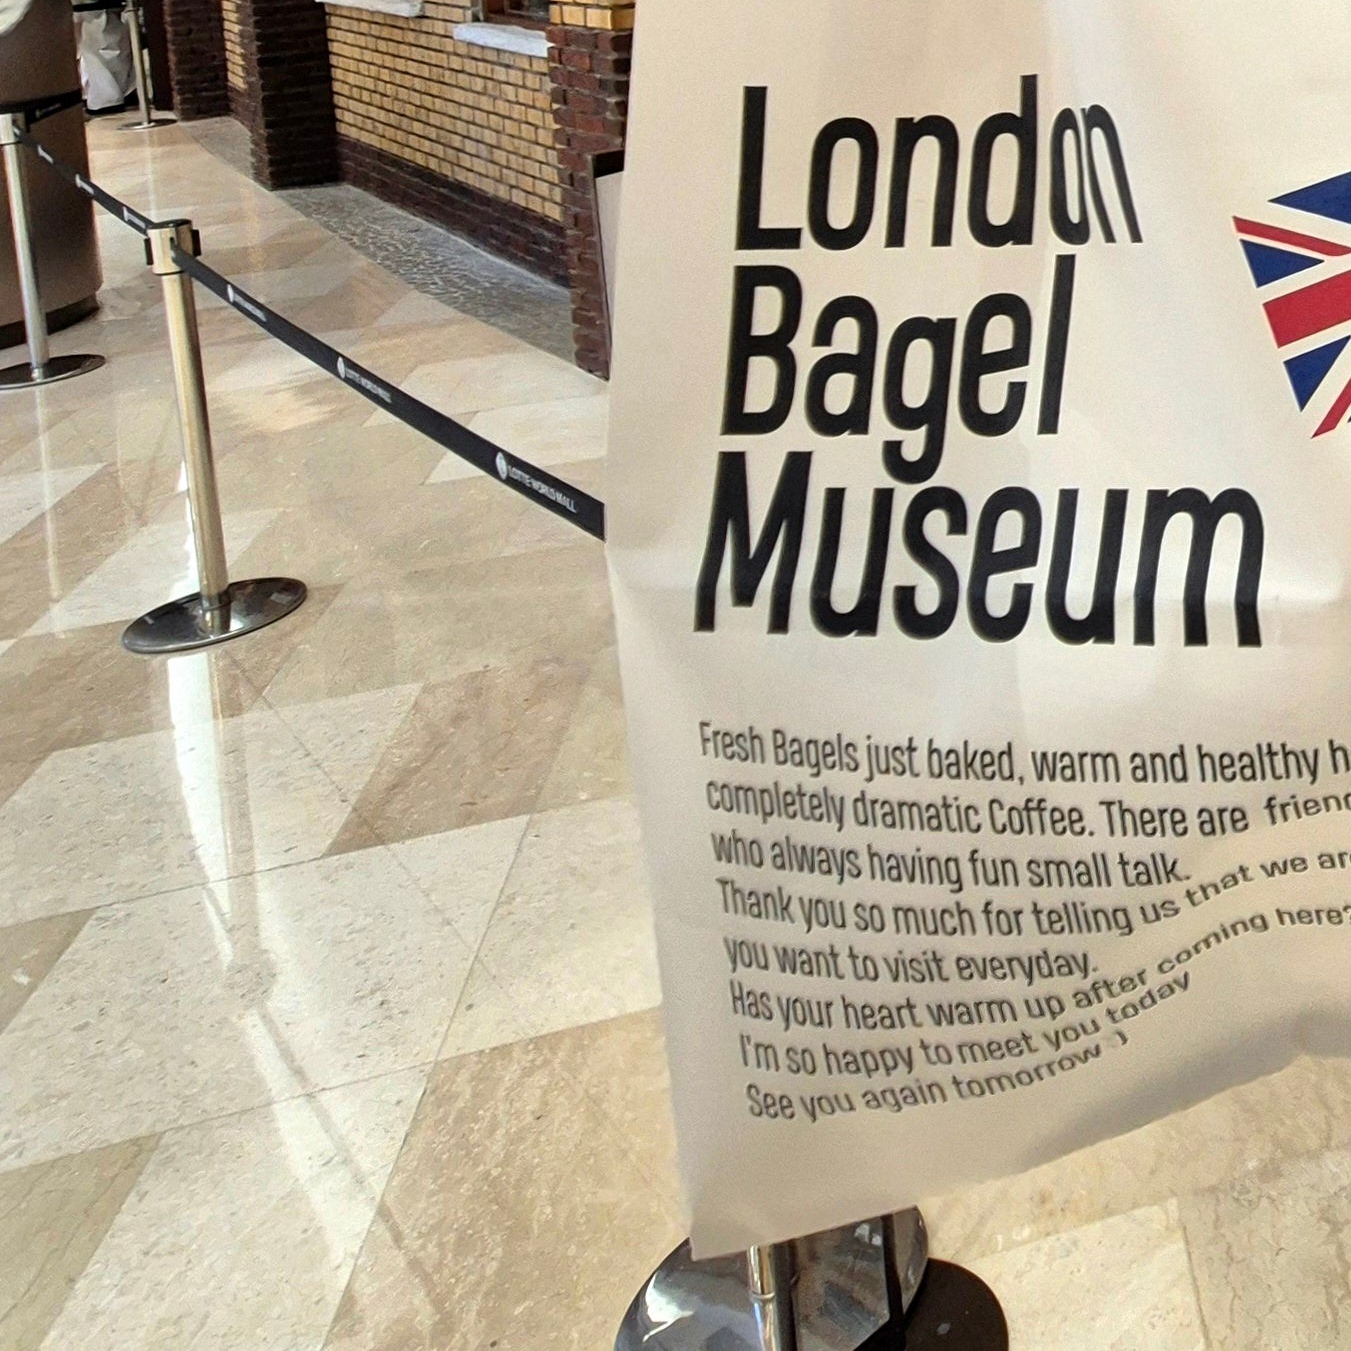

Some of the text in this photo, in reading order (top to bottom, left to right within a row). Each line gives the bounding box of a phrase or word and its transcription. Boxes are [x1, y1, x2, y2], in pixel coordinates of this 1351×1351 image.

[734, 74, 1143, 251] London
[720, 254, 1077, 485] Bagel
[693, 449, 1265, 648] Museum
[699, 719, 767, 765] Fresh
[772, 727, 860, 778] Bagels
[864, 734, 920, 782] just
[928, 740, 1025, 785] baked,
[1031, 750, 1121, 784] warm
[1129, 744, 1189, 784] and
[1197, 742, 1320, 785] healthy
[706, 780, 845, 831] completely
[853, 794, 982, 833] dramatic
[989, 798, 1095, 837] Coffee.
[1099, 800, 1189, 838] There
[1198, 806, 1250, 837] are
[711, 830, 1192, 894] who always having fun small talk.
[716, 877, 795, 923] Thank
[799, 894, 847, 934] you
[854, 905, 885, 933] so
[893, 902, 975, 937] much
[983, 902, 1024, 937] for
[1032, 901, 1133, 937] telling
[1141, 899, 1181, 925] us
[1185, 864, 1254, 908] that
[1260, 854, 1309, 879] we
[724, 937, 1098, 986] you want to visit everyday.
[730, 980, 773, 1021] Has
[777, 994, 834, 1033] your
[842, 996, 923, 1030] heart
[927, 999, 1017, 1027] warm
[1024, 994, 1067, 1022] up
[1072, 968, 1147, 1009] after
[1156, 911, 1269, 975] coming
[739, 970, 1190, 1080] I'm so happy to meet you today
[745, 1083, 795, 1120] See
[799, 1092, 856, 1123] you
[863, 1079, 948, 1113] again
[951, 1043, 1103, 1099] tomorrow
